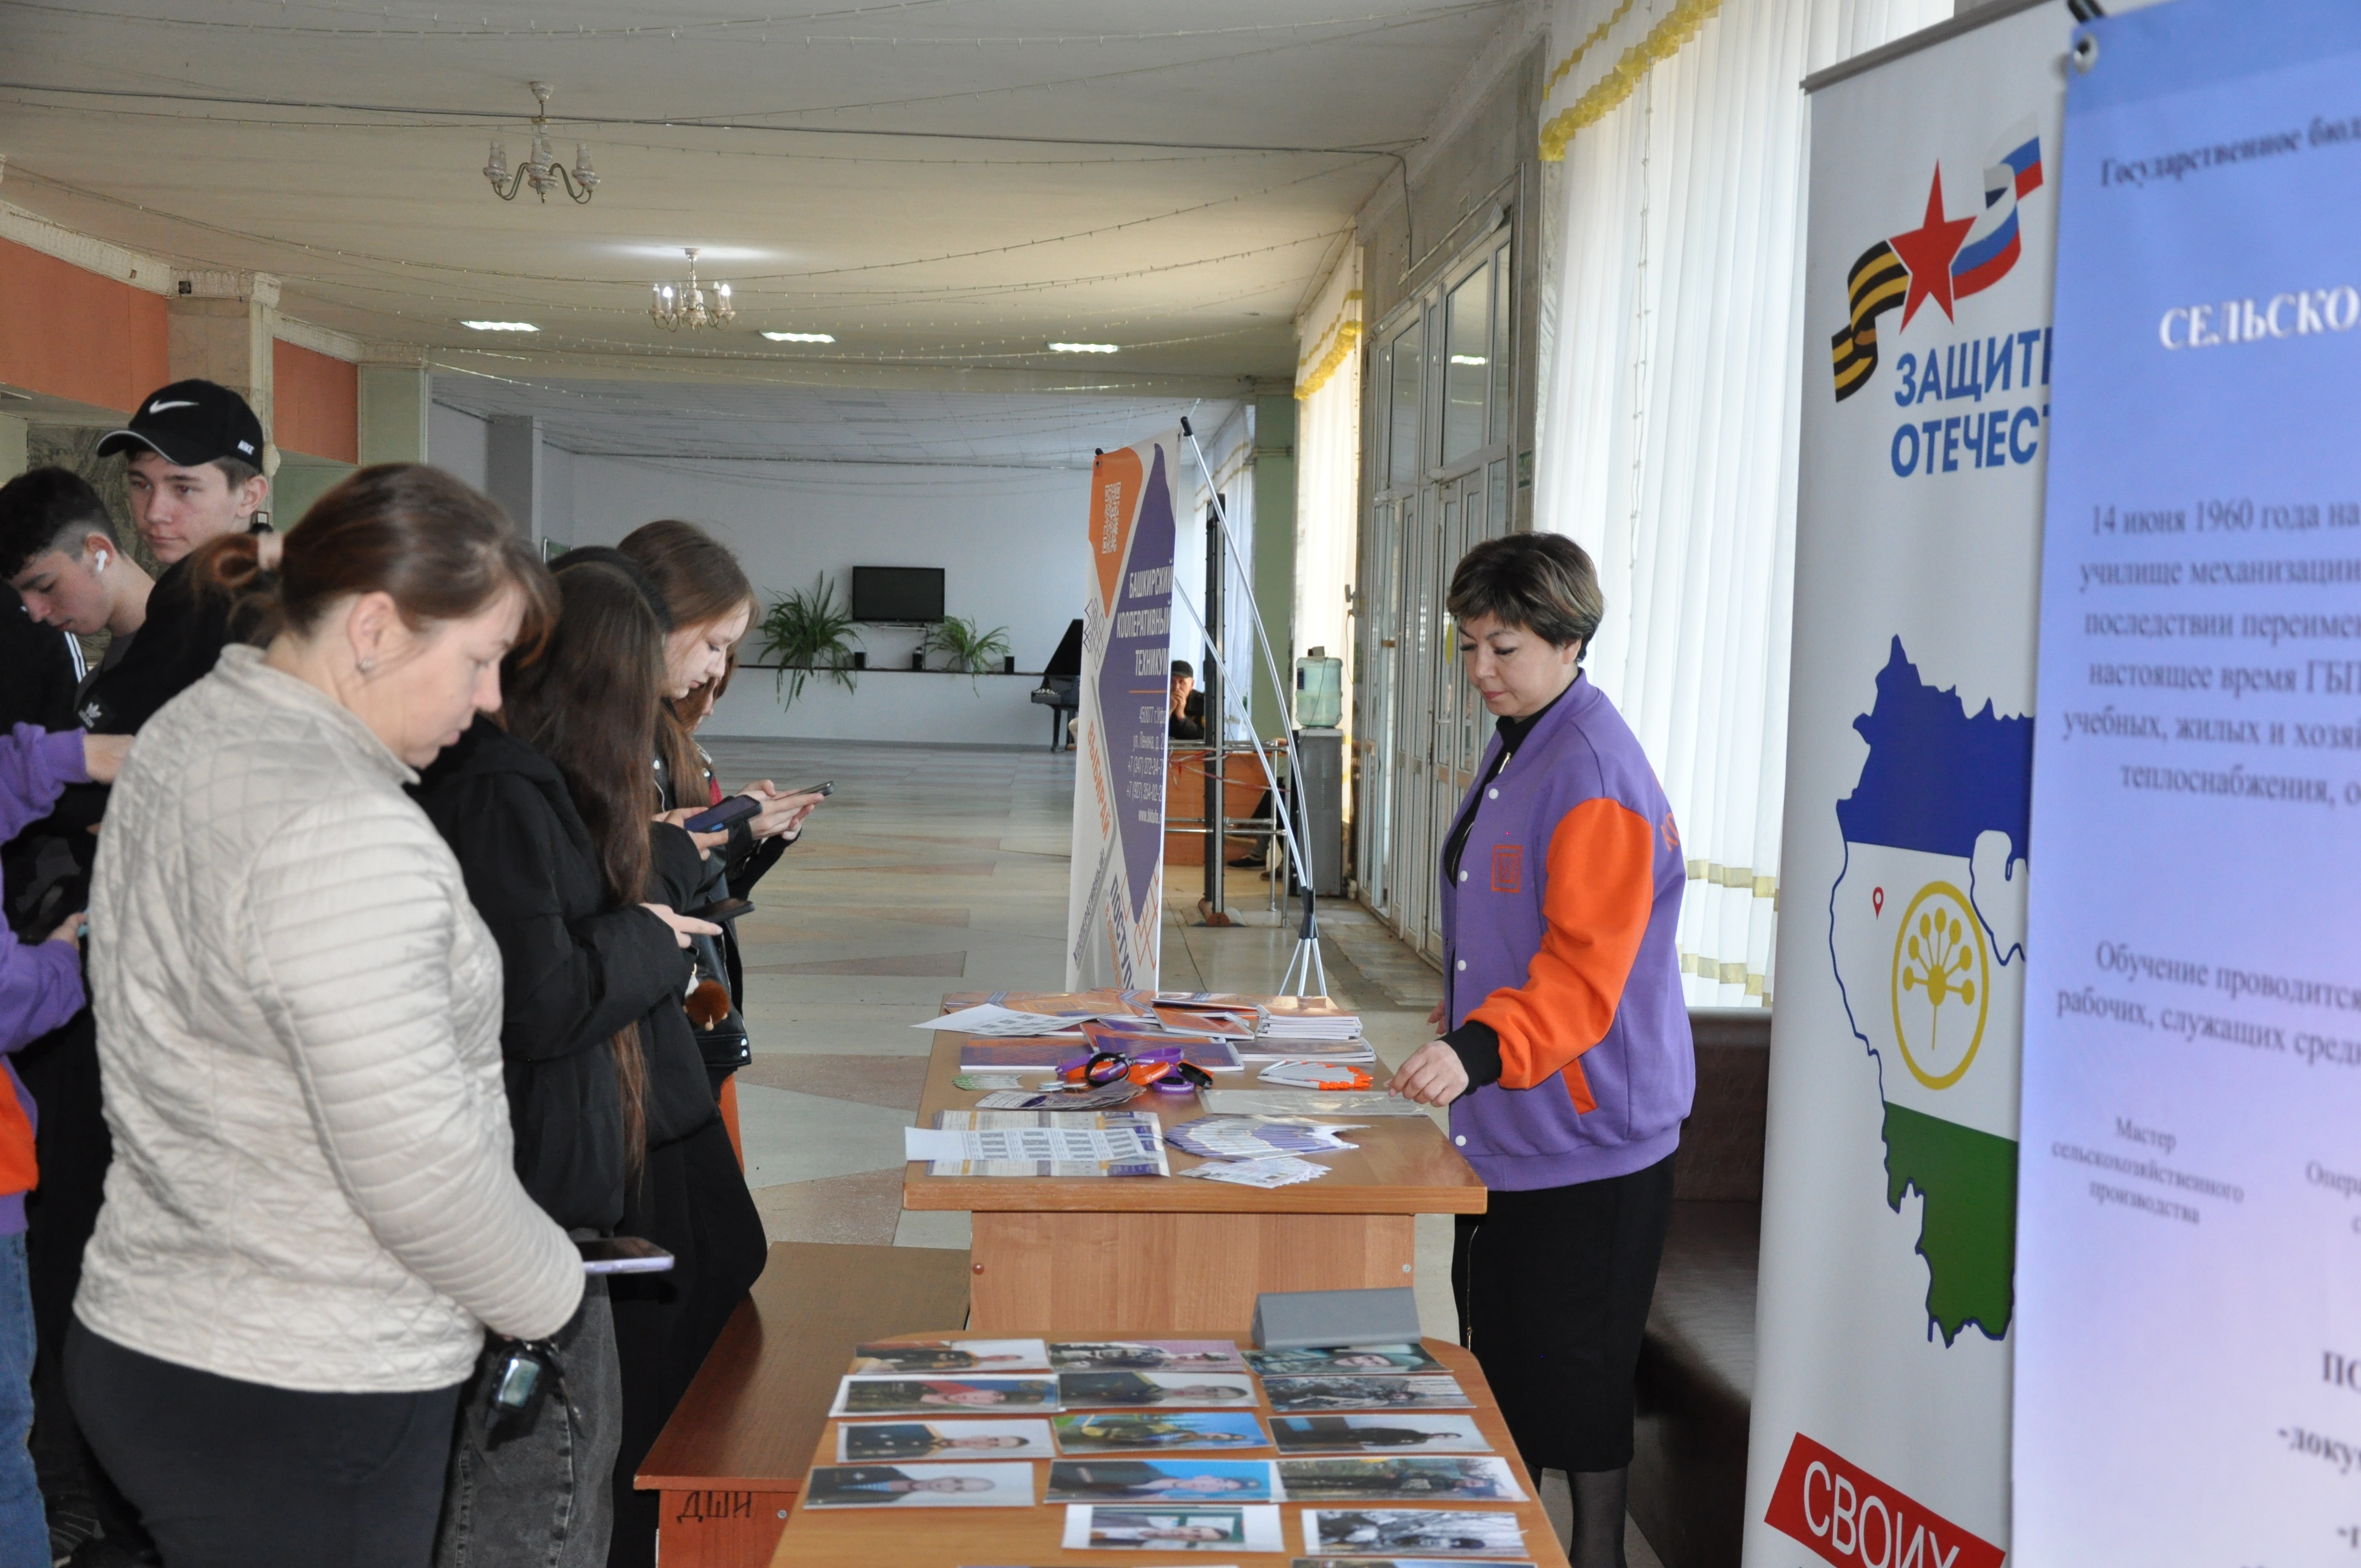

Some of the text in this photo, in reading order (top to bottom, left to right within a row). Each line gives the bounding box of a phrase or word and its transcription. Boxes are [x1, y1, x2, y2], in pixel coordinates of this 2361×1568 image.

[2101, 129, 2302, 187] Государственное
[2159, 285, 2360, 351] СЕЛЬСКО
[238, 440, 254, 455] NIKE
[1891, 404, 2049, 478] ОТЕЧЕС
[2093, 504, 2116, 535] 14
[2123, 510, 2186, 534] июня
[2196, 499, 2254, 532] 1960
[2262, 504, 2320, 530] года
[1129, 558, 1173, 598] БАШКИРСКИЙ
[2079, 562, 2183, 594] училище
[1117, 599, 1171, 638] КООПЕРАТИВНЫЙ
[2085, 613, 2233, 637] последствии
[2089, 663, 2212, 690] настоящее
[2220, 667, 2296, 699] время
[2063, 705, 2168, 741] учебных,
[2175, 717, 2260, 743] жилых
[2269, 721, 2285, 746] и
[1088, 720, 1111, 841] ВЫБИРАЙ
[2121, 764, 2335, 808] теплоснабжения,
[2096, 940, 2209, 986] Обучение
[2057, 986, 2154, 1031] рабочих,
[2161, 1008, 2286, 1050] служащих
[2115, 1117, 2176, 1154] Мастер
[2090, 1180, 2200, 1225] производства
[676, 1490, 752, 1523] ДШИ
